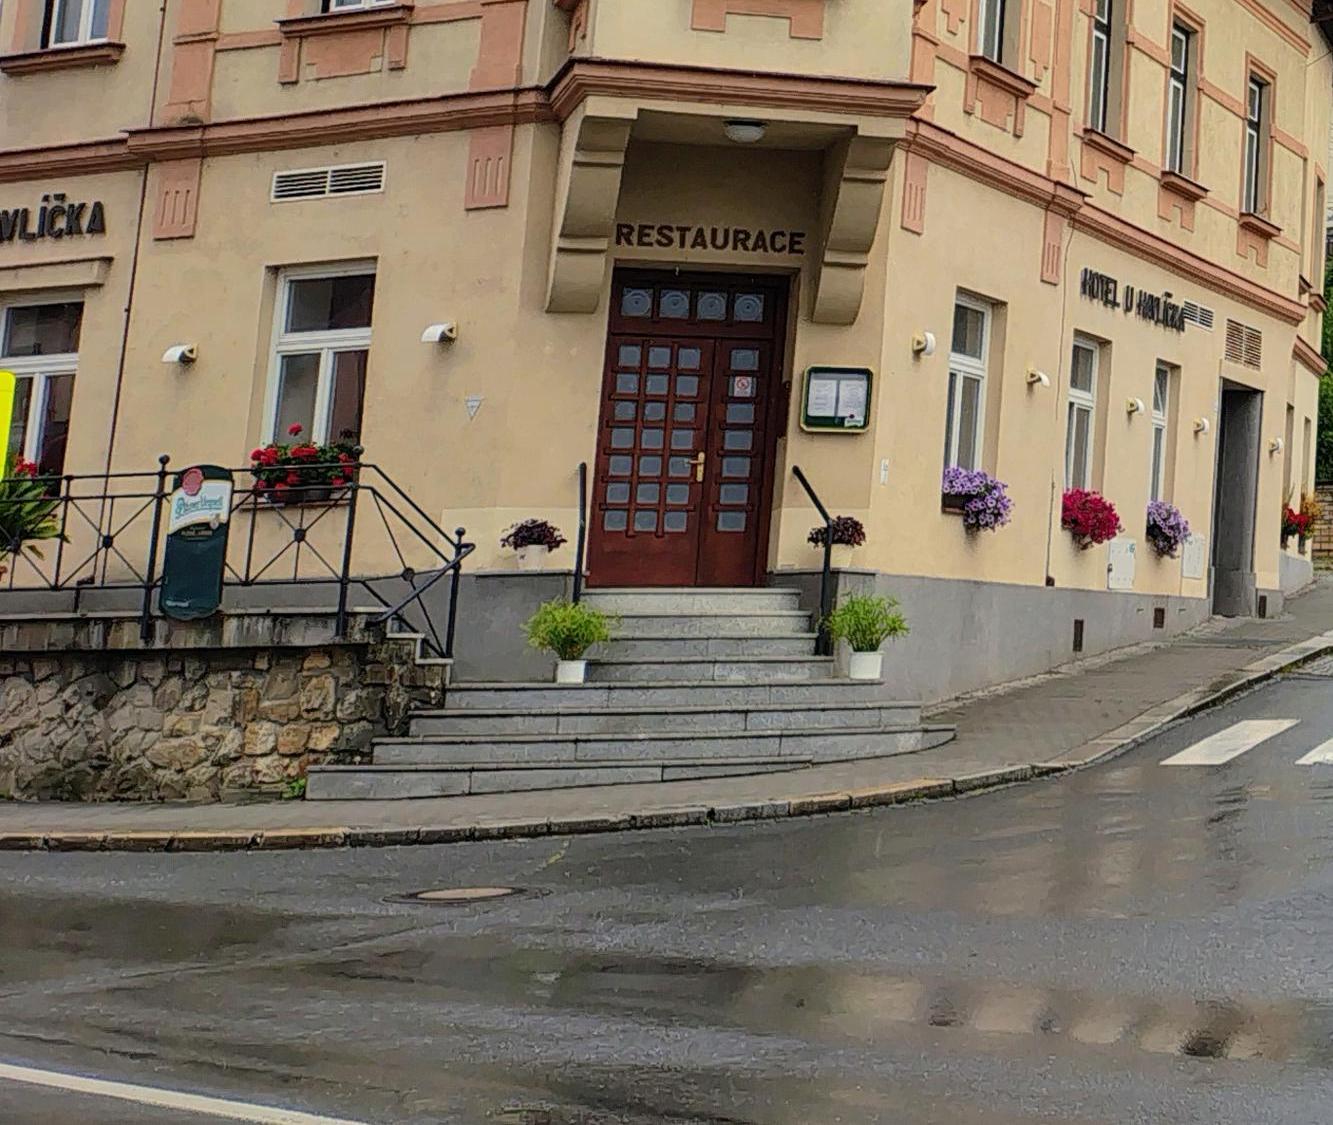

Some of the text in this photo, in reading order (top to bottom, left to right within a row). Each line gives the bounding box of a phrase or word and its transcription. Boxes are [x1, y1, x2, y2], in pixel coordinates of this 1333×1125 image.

[0, 193, 106, 243] VLÍČKA
[615, 223, 806, 255] RESTAURACE
[1080, 267, 1120, 309] HOTEL
[1123, 285, 1135, 313] U
